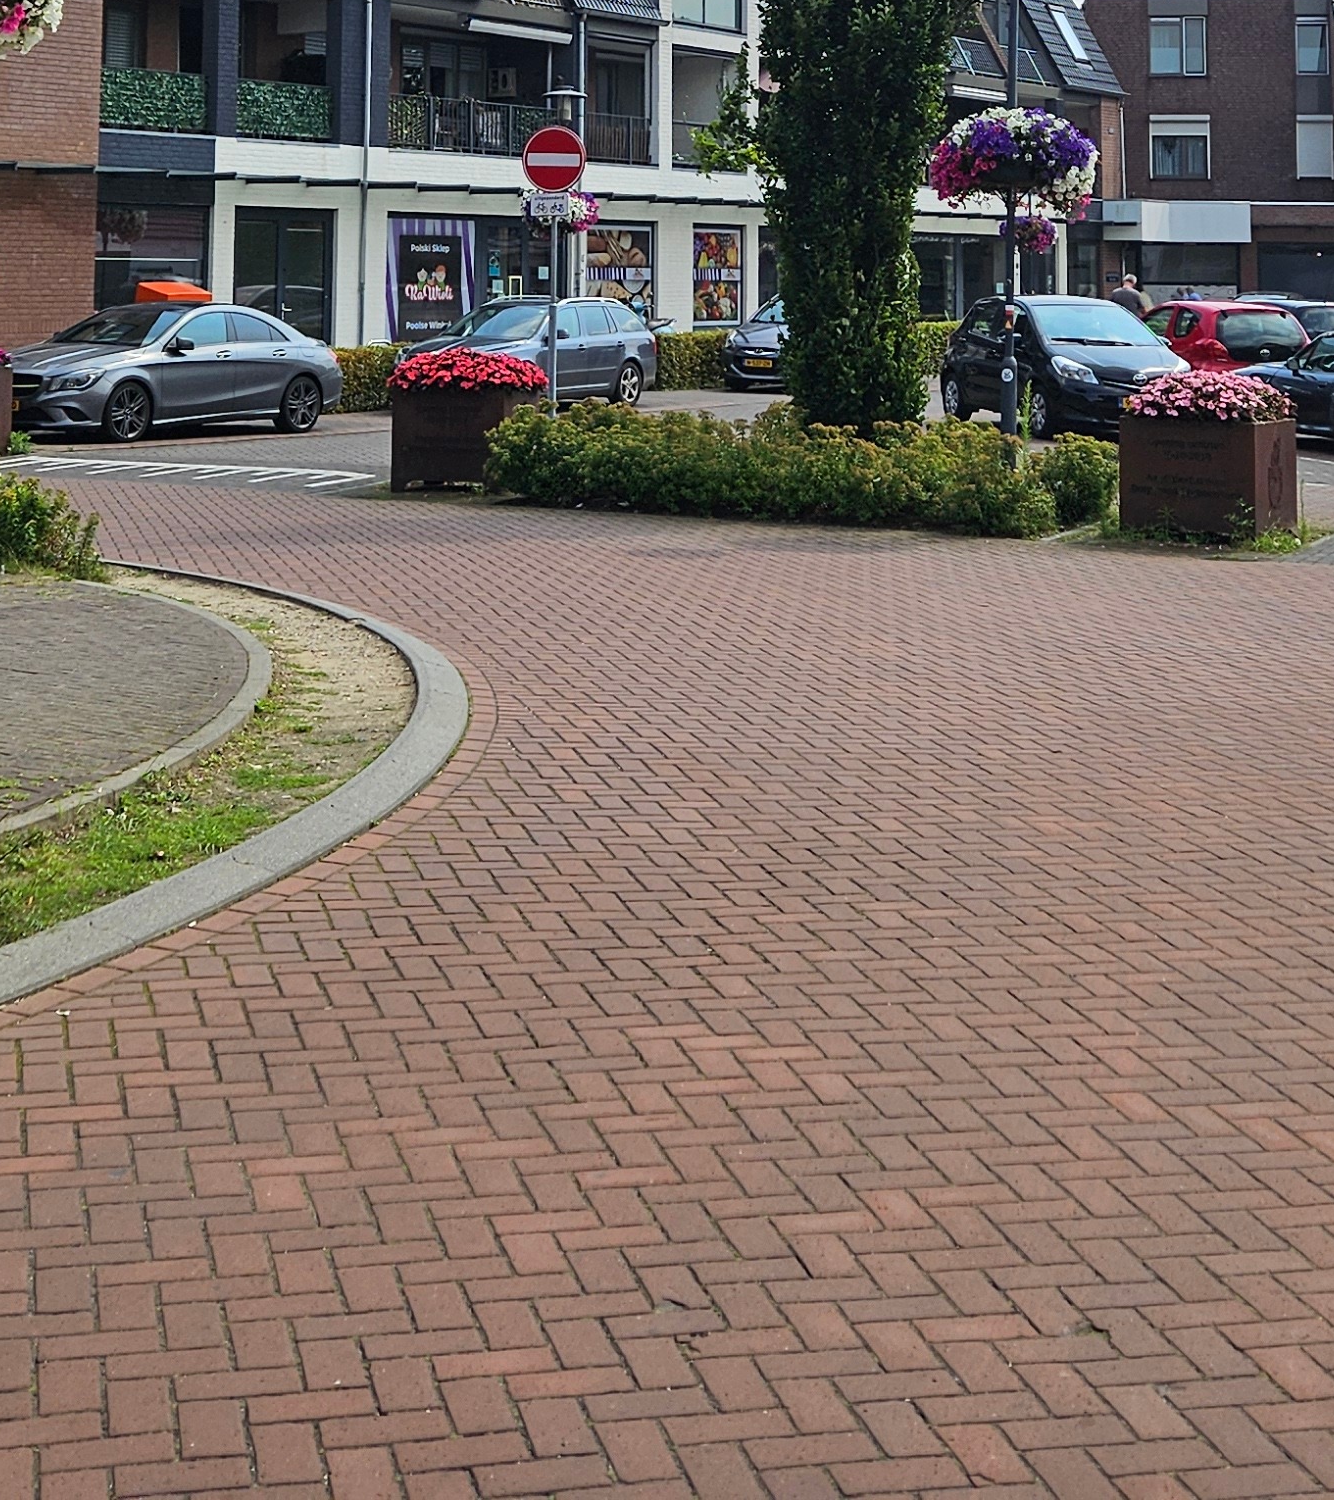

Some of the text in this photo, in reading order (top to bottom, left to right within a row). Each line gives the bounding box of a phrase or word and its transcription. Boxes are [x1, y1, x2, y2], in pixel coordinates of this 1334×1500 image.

[410, 244, 450, 253] Polski Sklep
[406, 320, 452, 330] Poolse Winkl
